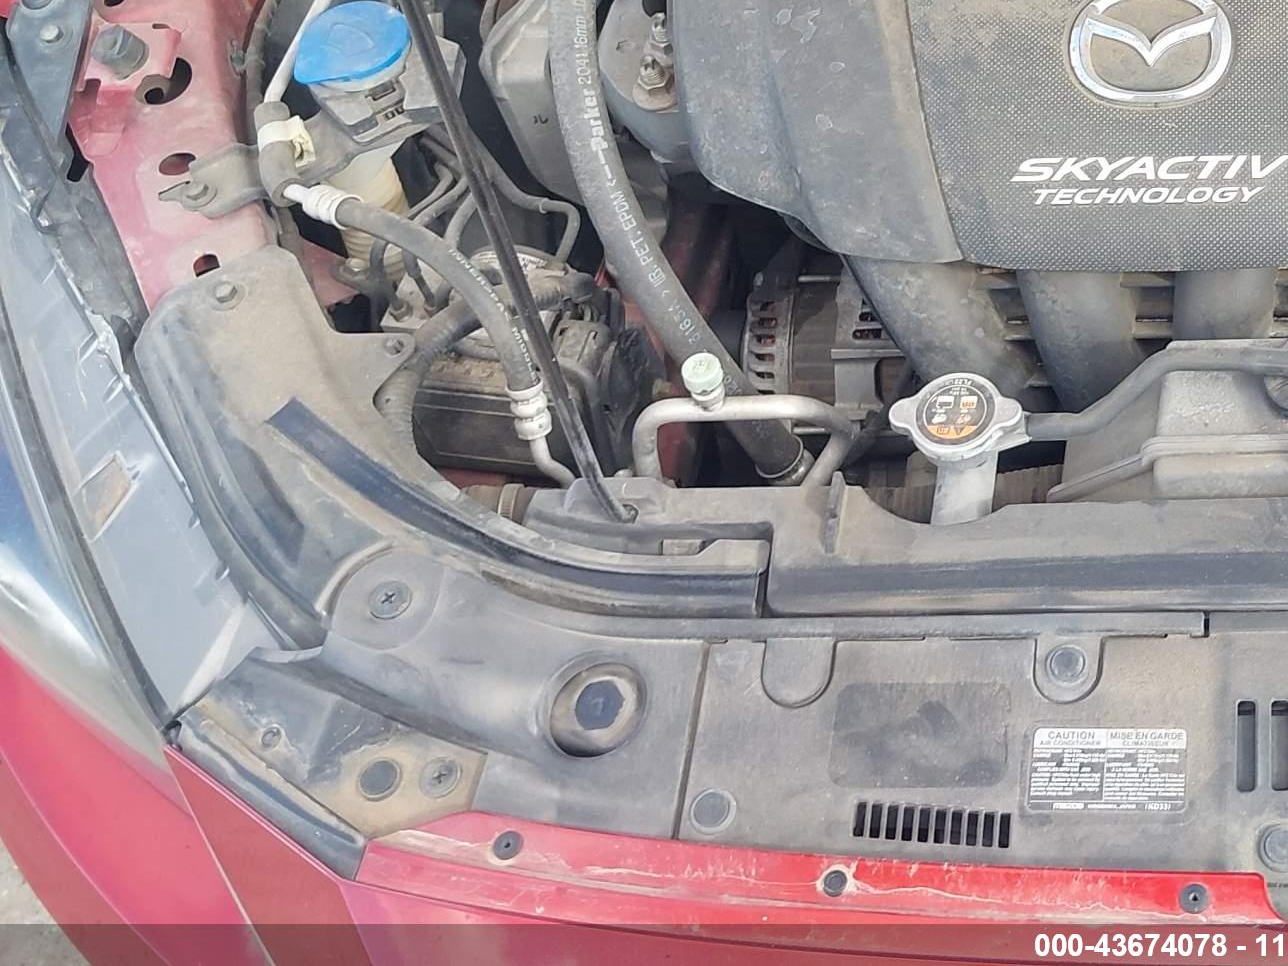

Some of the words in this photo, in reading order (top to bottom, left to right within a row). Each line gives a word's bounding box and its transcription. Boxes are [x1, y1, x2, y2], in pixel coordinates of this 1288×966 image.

[584, 89, 609, 151] Parker
[1034, 186, 1266, 205] TECHNOLOGY
[609, 190, 637, 230] EPDM
[1047, 731, 1095, 740] CAUTION
[1110, 731, 1133, 740] MISE
[1135, 731, 1149, 740] EN
[1150, 731, 1184, 740] GARDE
